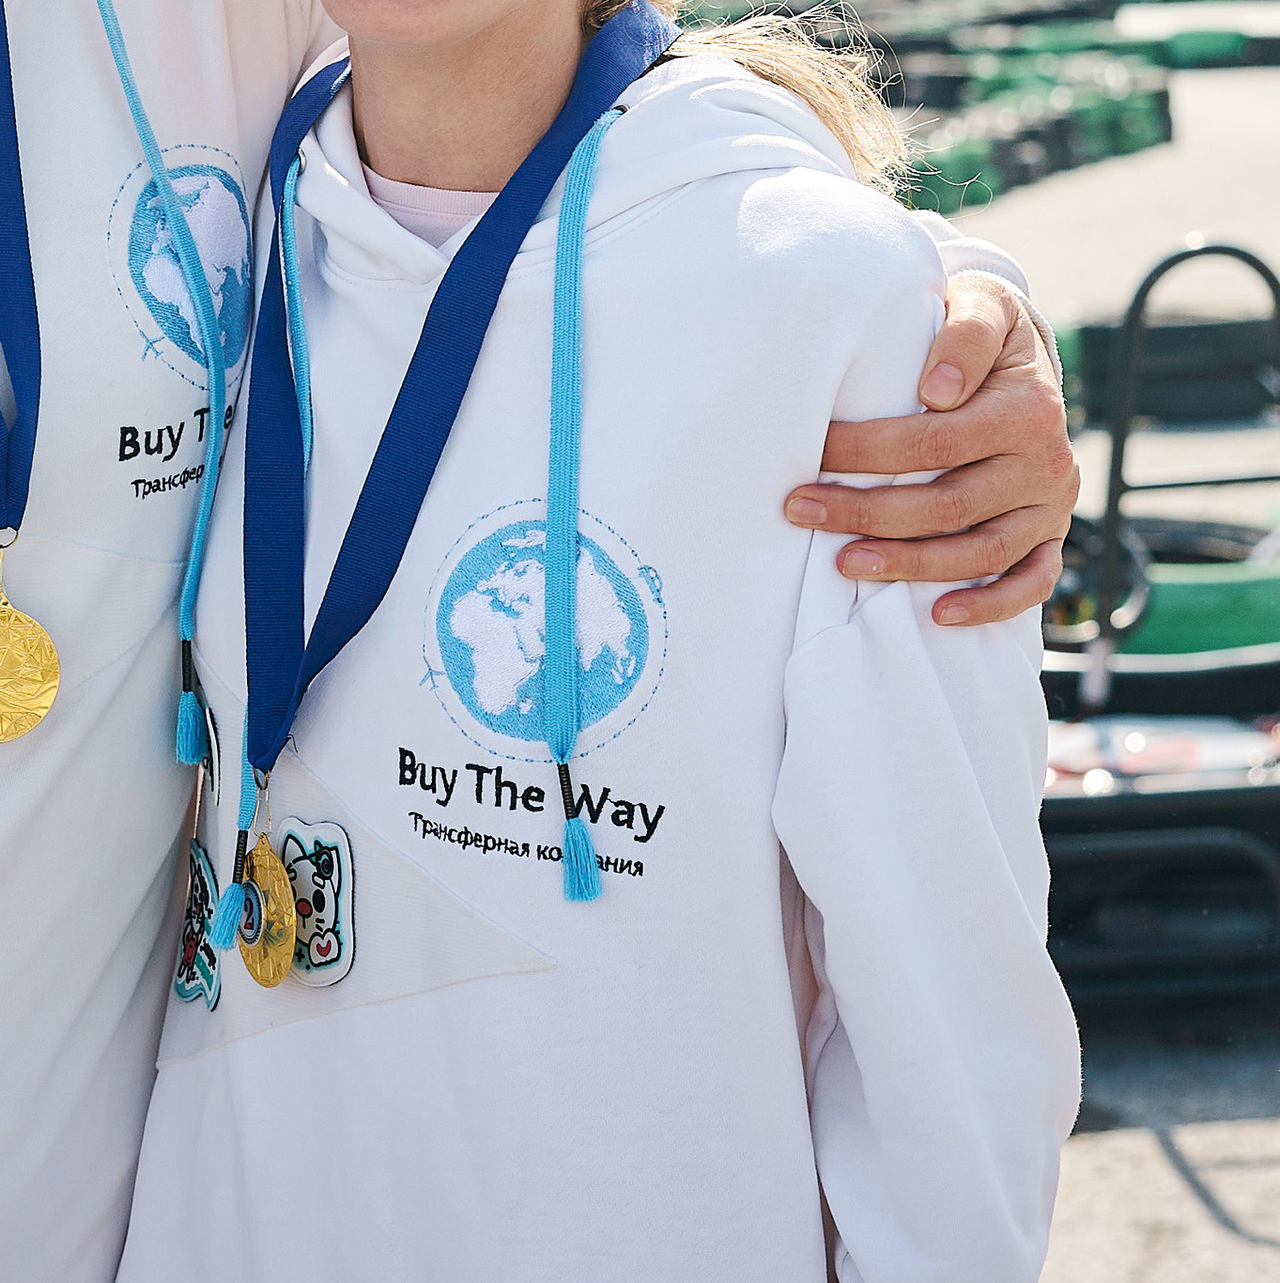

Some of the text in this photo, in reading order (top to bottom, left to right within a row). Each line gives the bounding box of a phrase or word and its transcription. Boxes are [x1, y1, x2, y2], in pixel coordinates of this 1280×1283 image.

[118, 404, 233, 463] Buy Te
[130, 459, 223, 500] Трансфер
[398, 747, 666, 844] Buy The Way
[408, 810, 644, 877] Трансферная коания
[243, 897, 255, 930] 2
